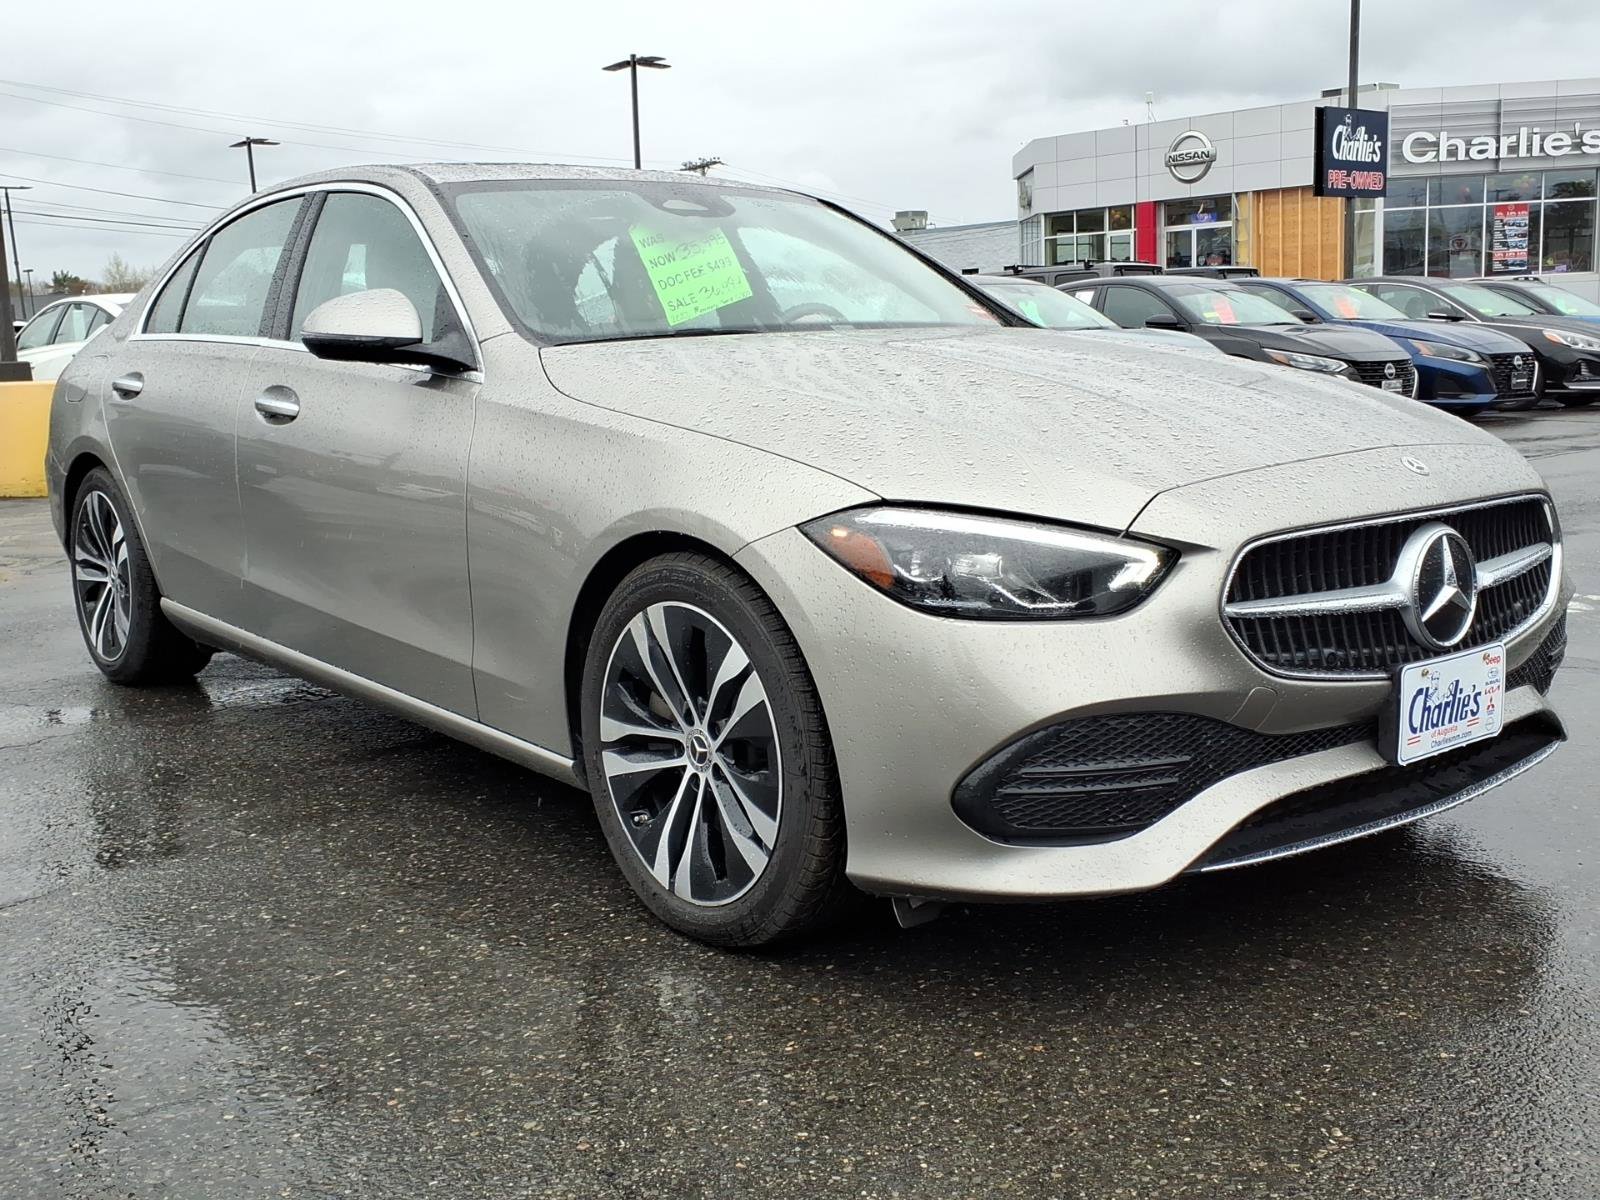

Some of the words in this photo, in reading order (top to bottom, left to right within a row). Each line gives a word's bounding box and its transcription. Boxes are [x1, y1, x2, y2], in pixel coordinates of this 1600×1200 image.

[1332, 124, 1382, 163] Charlie's
[1402, 122, 1600, 164] Charlie's
[1168, 150, 1210, 163] NISSAN
[1327, 169, 1384, 190] PRE-OWNED
[638, 233, 665, 249] WAS
[649, 250, 676, 269] NOW
[658, 273, 684, 291] DOC
[683, 265, 705, 281] FEE
[667, 292, 698, 312] SALE
[1408, 679, 1481, 735] Charlie's
